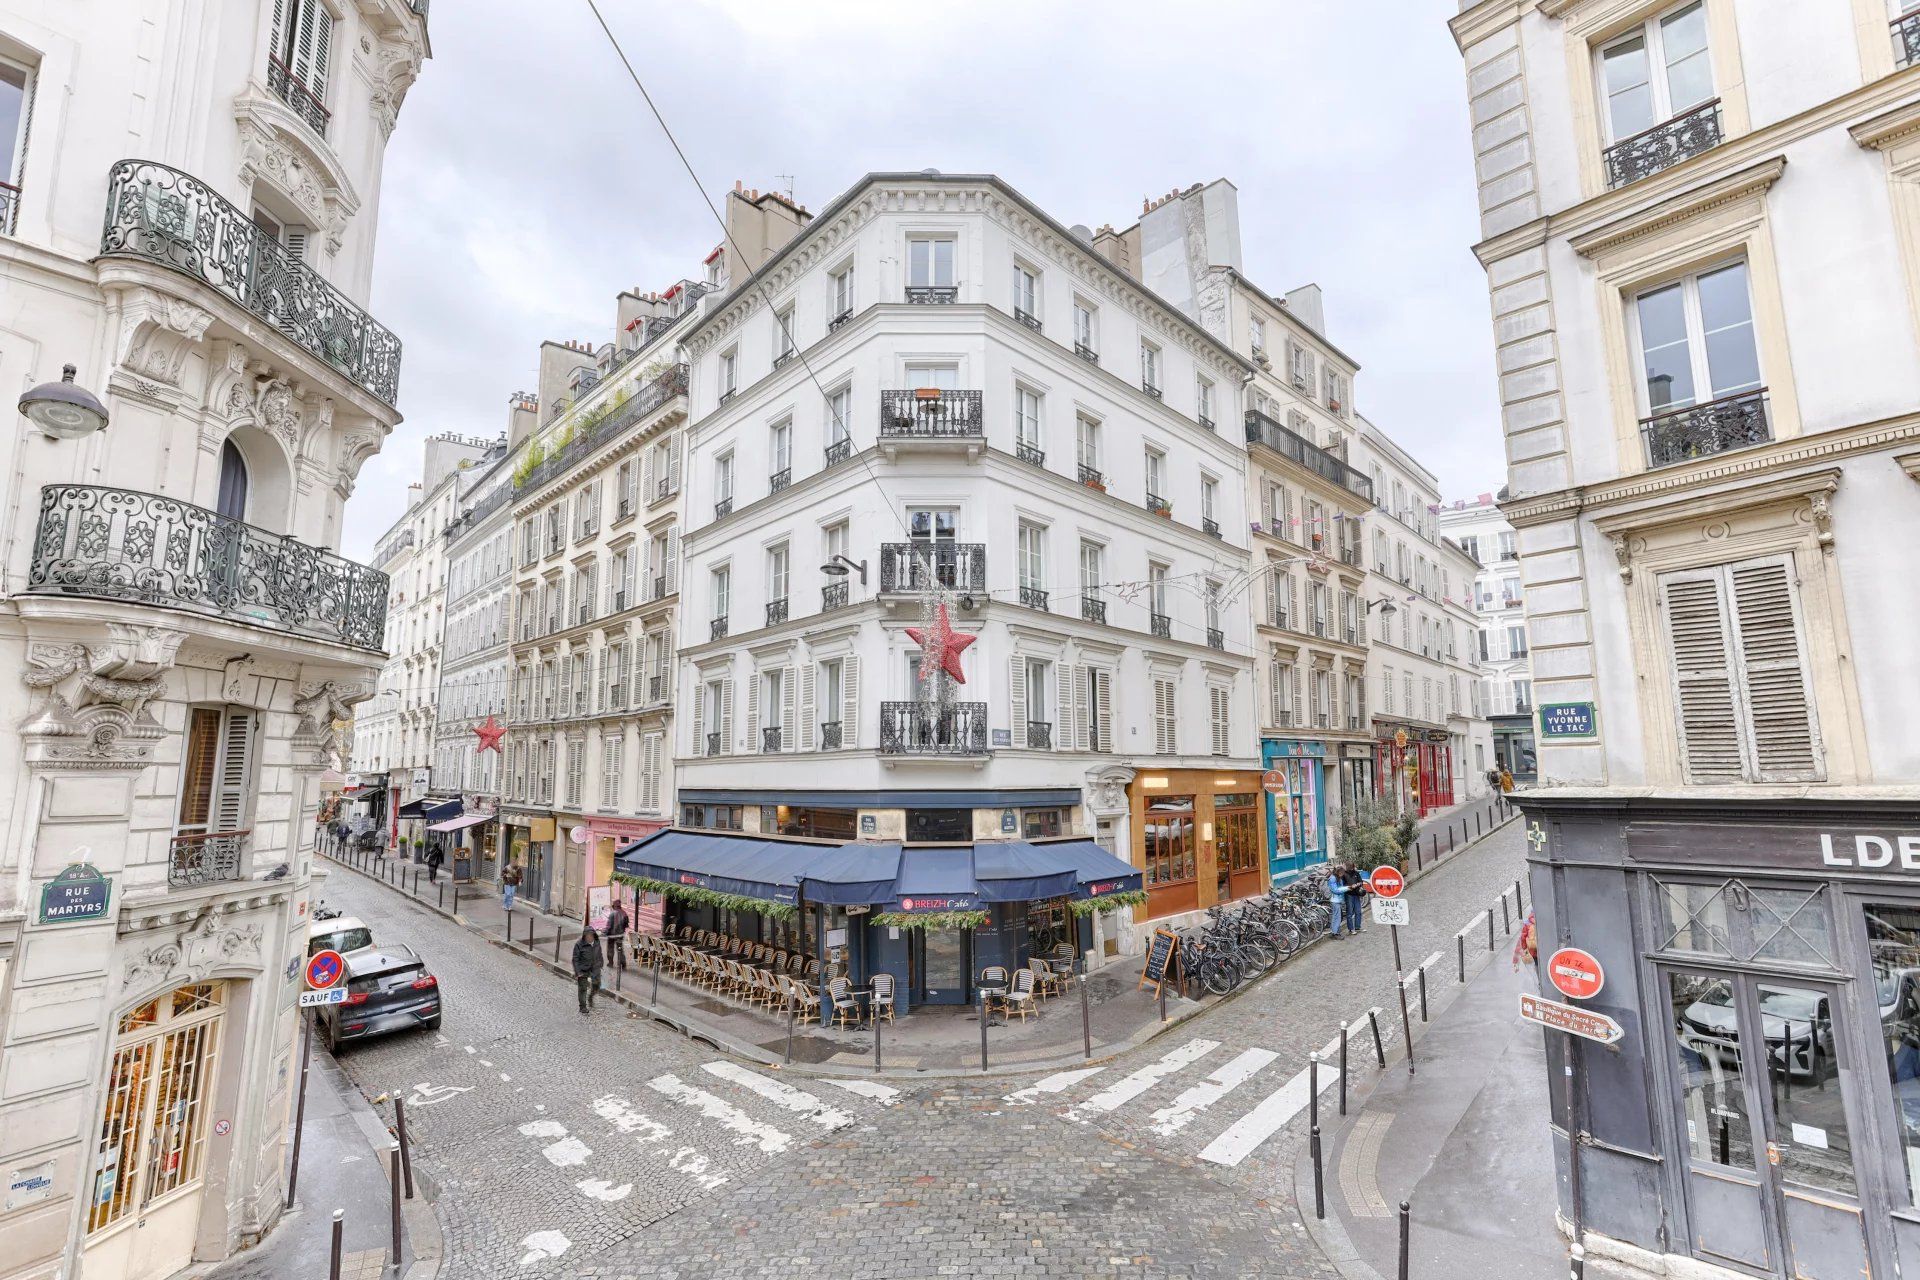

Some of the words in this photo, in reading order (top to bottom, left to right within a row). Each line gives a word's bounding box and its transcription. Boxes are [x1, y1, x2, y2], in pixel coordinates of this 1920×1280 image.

[1556, 707, 1577, 716] RUE
[1547, 716, 1588, 724] YVONNE
[1566, 724, 1584, 732] TAC
[65, 887, 90, 897] RUE
[915, 899, 947, 908] BREIZH
[947, 899, 969, 908] Café
[47, 903, 102, 916] MARTYRS
[302, 993, 329, 1004] SAUF
[1545, 1014, 1565, 1024] Place
[1568, 1021, 1578, 1029] du
[1571, 1014, 1589, 1024] Sacré
